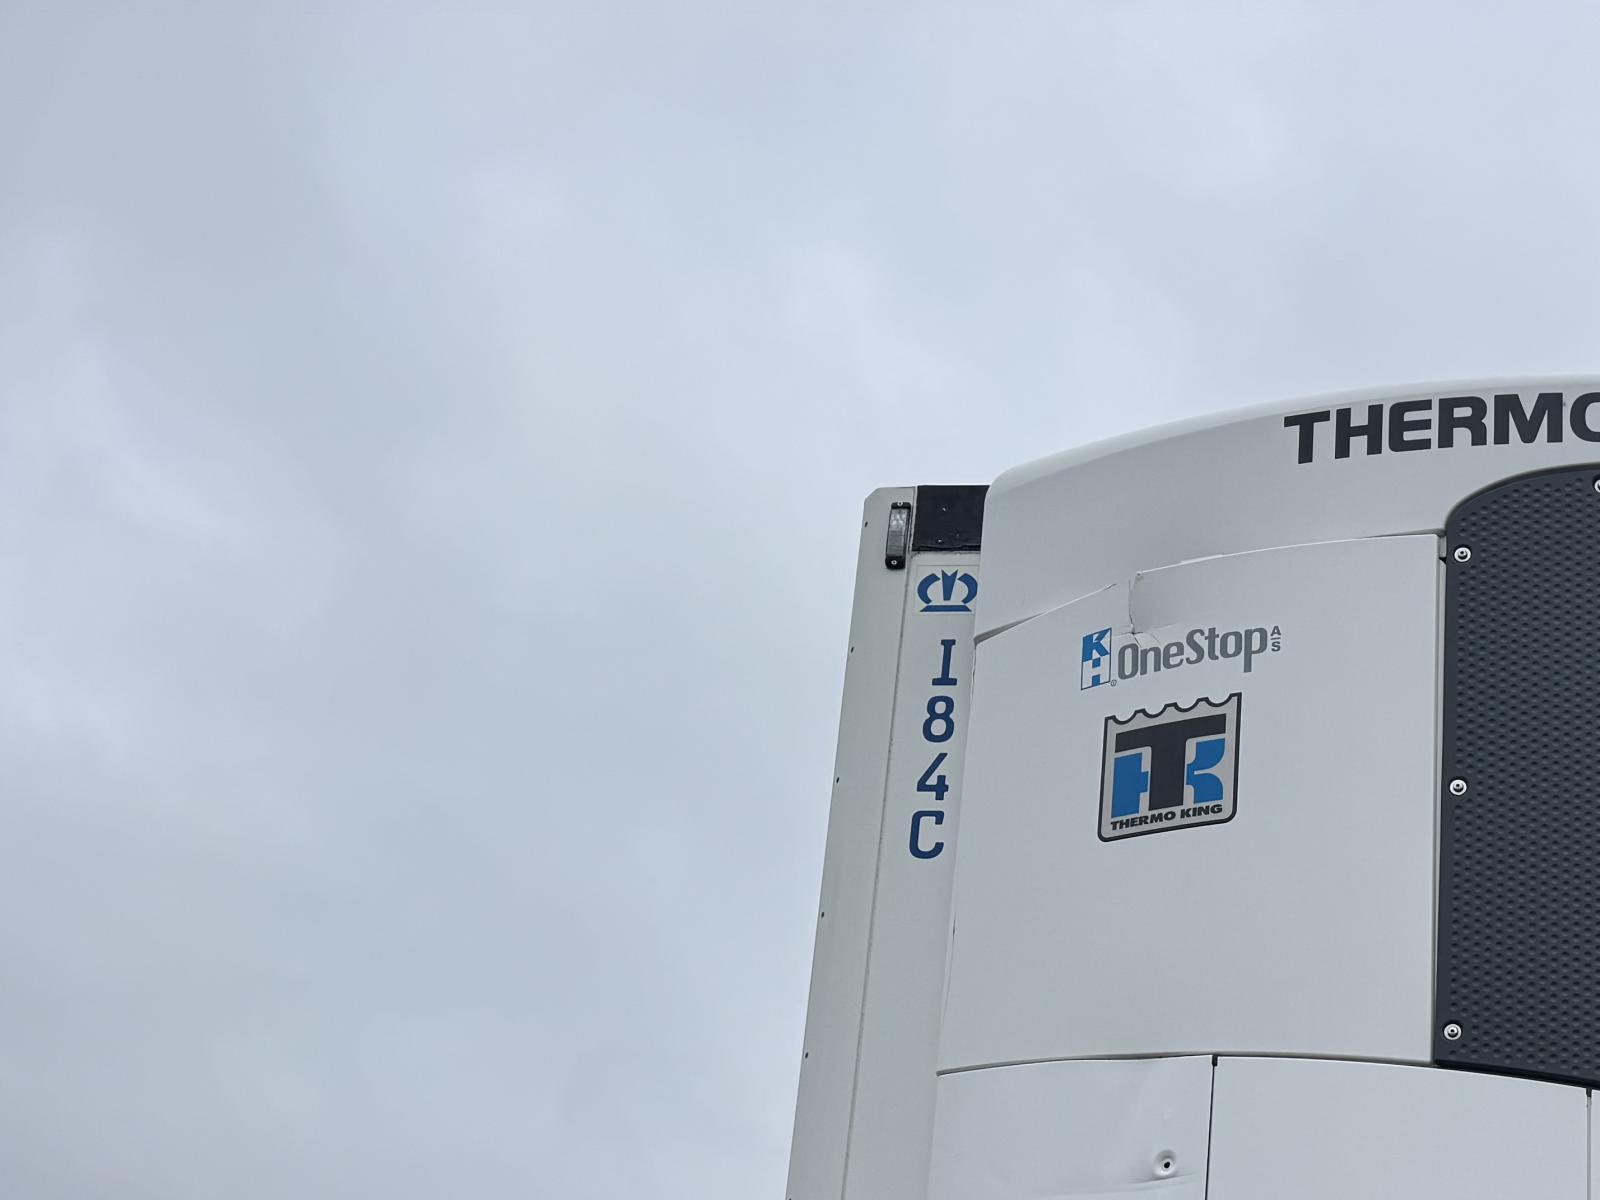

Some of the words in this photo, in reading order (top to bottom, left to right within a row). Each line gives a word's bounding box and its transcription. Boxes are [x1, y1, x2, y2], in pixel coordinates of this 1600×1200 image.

[1117, 627, 1268, 680] OneStop
[1110, 811, 1176, 831] THERMO
[1180, 804, 1223, 819] KING
